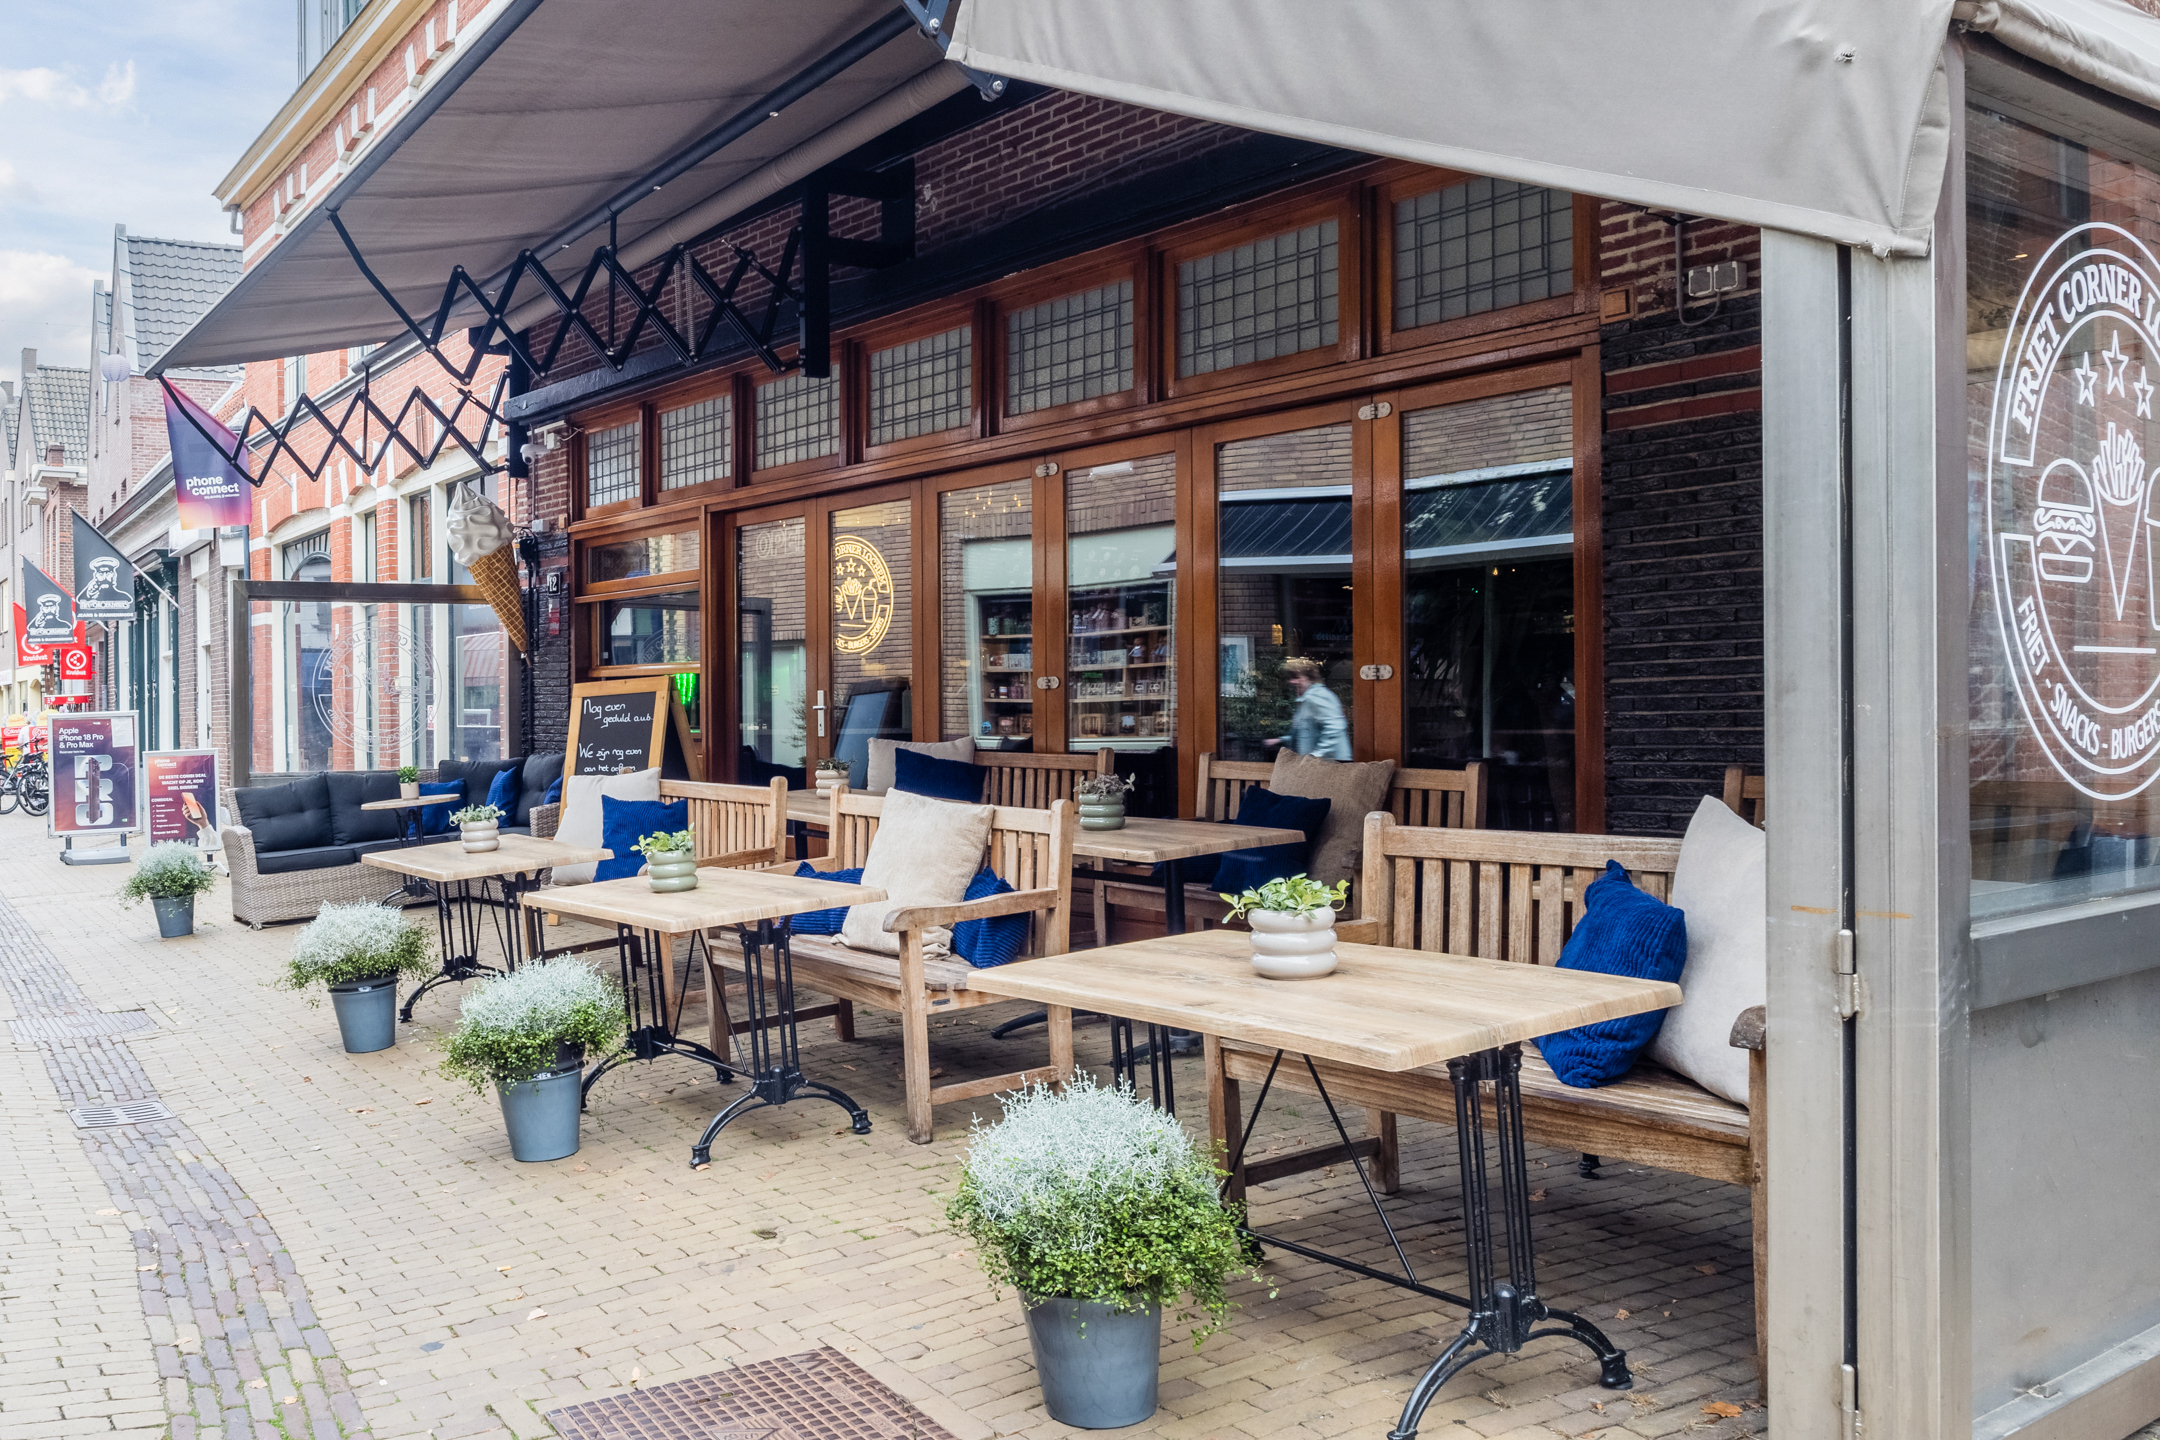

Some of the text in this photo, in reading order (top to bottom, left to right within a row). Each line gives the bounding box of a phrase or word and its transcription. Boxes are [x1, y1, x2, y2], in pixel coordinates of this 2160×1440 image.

[2012, 302, 2061, 434] FRIET
[2058, 263, 2142, 324] CORNER
[186, 476, 223, 490] phone
[192, 483, 239, 496] connect
[835, 544, 887, 587] ORNER LOCHEM
[847, 636, 870, 650] BURGERS
[22, 654, 48, 662] Kruidvat
[2018, 595, 2050, 676] FRIET
[2050, 682, 2101, 755] SNACKS
[583, 698, 626, 720] Nog even
[600, 712, 632, 729] geduld
[59, 727, 79, 735] Apple
[92, 733, 104, 741] Pro
[59, 741, 66, 749] &
[66, 741, 78, 749] Pro
[578, 743, 642, 761] We zijn nog even
[598, 764, 610, 772] het
